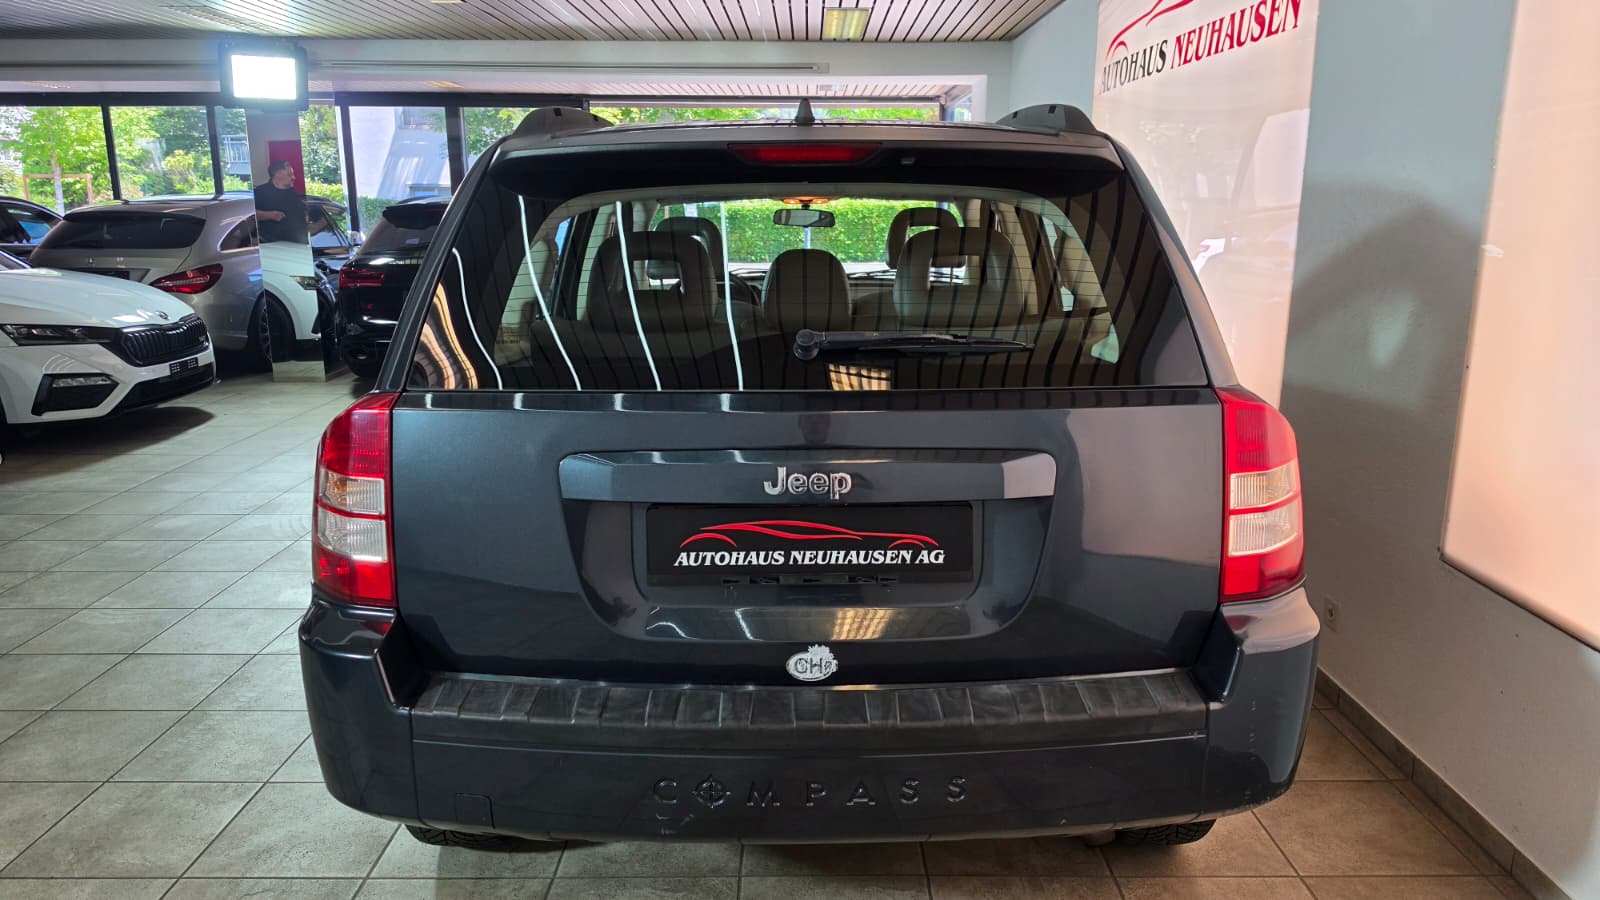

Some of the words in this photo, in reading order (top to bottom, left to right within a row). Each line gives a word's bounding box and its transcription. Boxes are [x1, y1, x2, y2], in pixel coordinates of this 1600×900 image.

[1099, 39, 1168, 95] AUTOHAUS
[1170, 0, 1301, 69] NEUHAUSEN
[763, 466, 852, 500] Jeep
[674, 551, 785, 566] AUTOHAUS
[789, 550, 913, 565] NEUHAUSEN
[915, 550, 945, 564] AG
[653, 774, 967, 807] COMPASS
